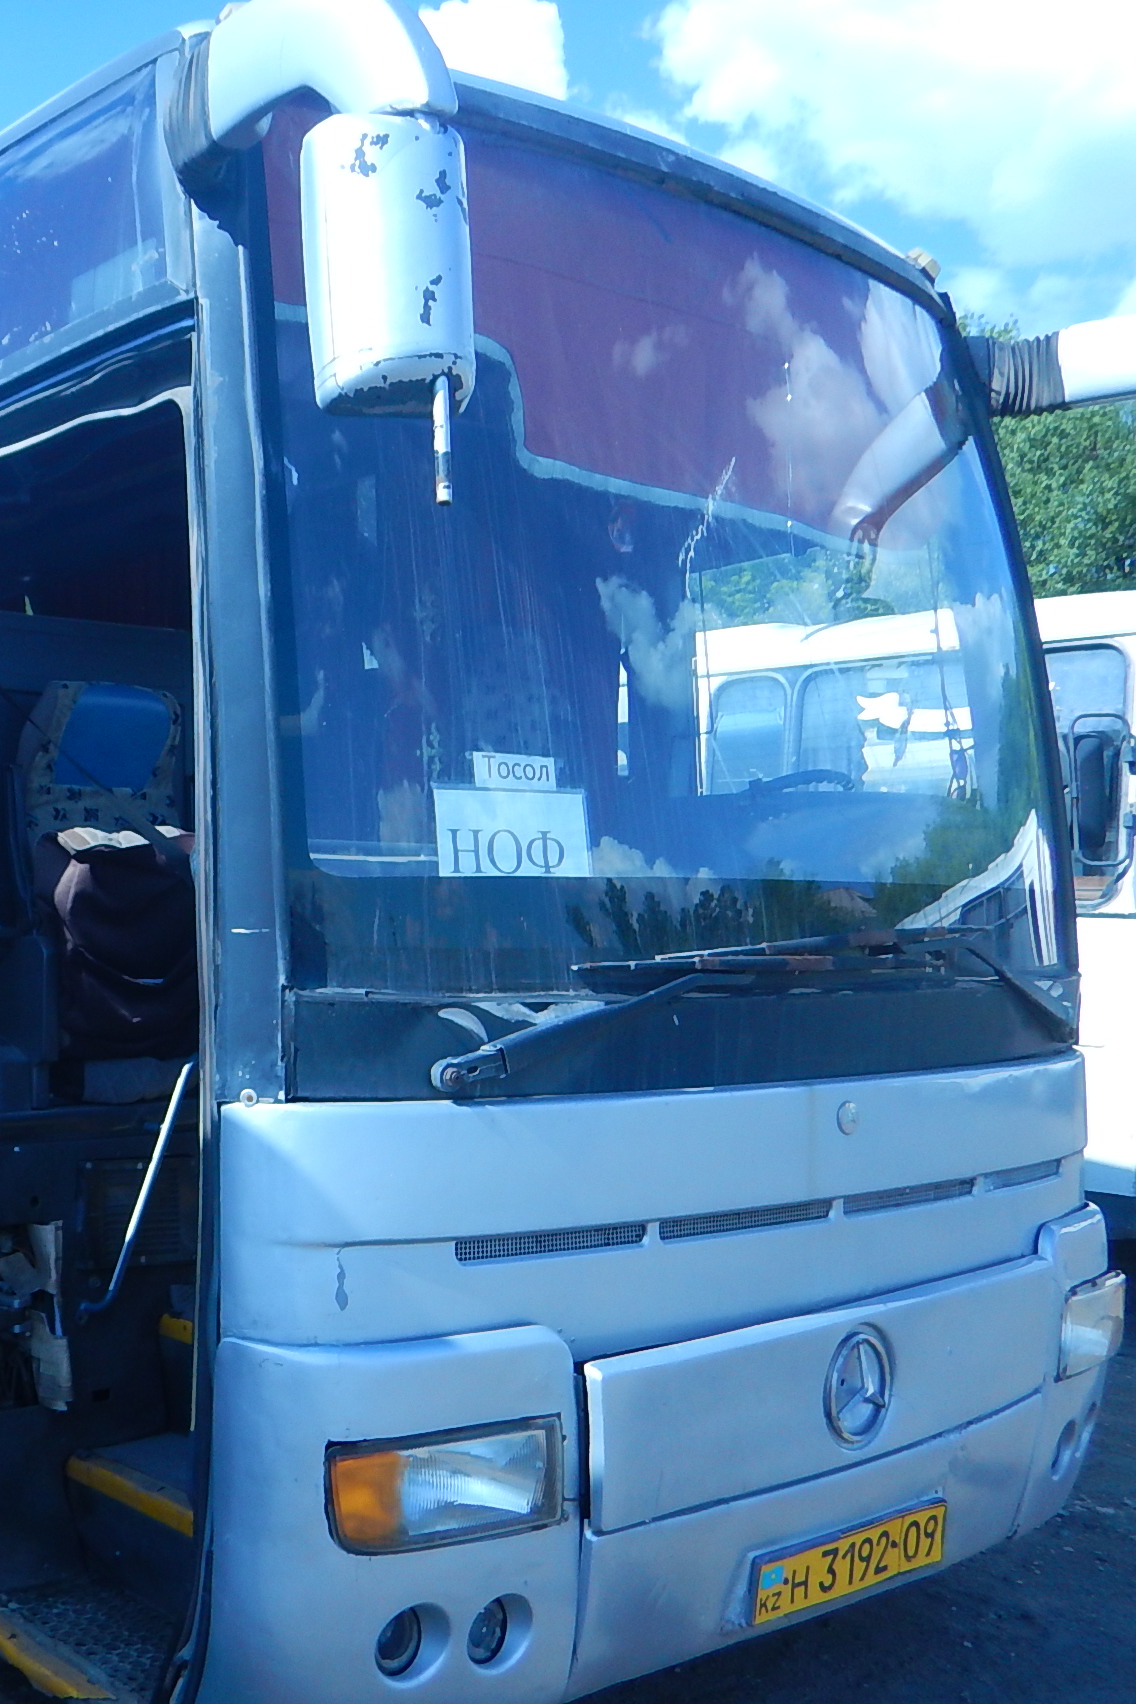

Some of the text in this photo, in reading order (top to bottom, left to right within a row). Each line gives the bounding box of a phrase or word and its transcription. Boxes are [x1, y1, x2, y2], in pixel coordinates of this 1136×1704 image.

[481, 754, 550, 782] Тосол
[446, 828, 565, 875] НОФ
[758, 1590, 782, 1616] KZ
